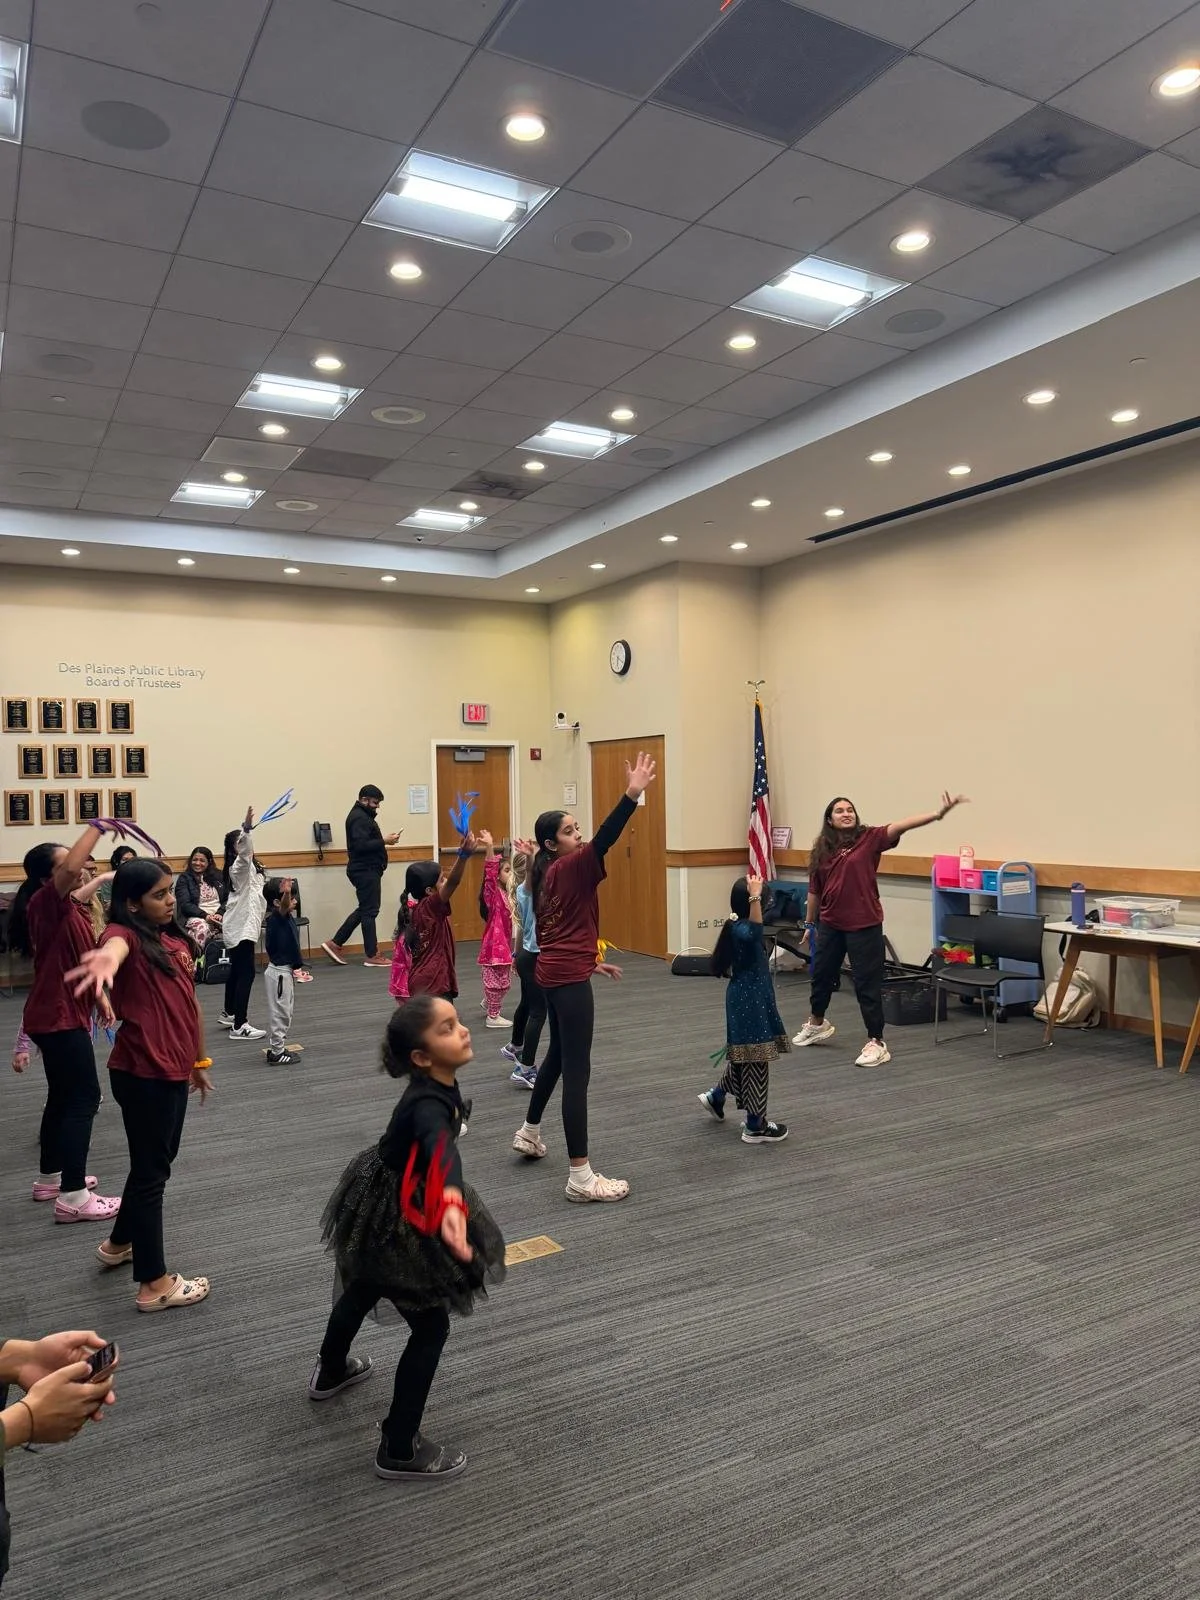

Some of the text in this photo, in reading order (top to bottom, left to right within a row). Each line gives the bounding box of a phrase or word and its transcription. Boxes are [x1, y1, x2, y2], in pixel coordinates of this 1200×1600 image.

[58, 662, 206, 680] Des Plaines Public Library
[86, 676, 182, 689] Board of Trustees
[467, 704, 487, 721] EXIT
